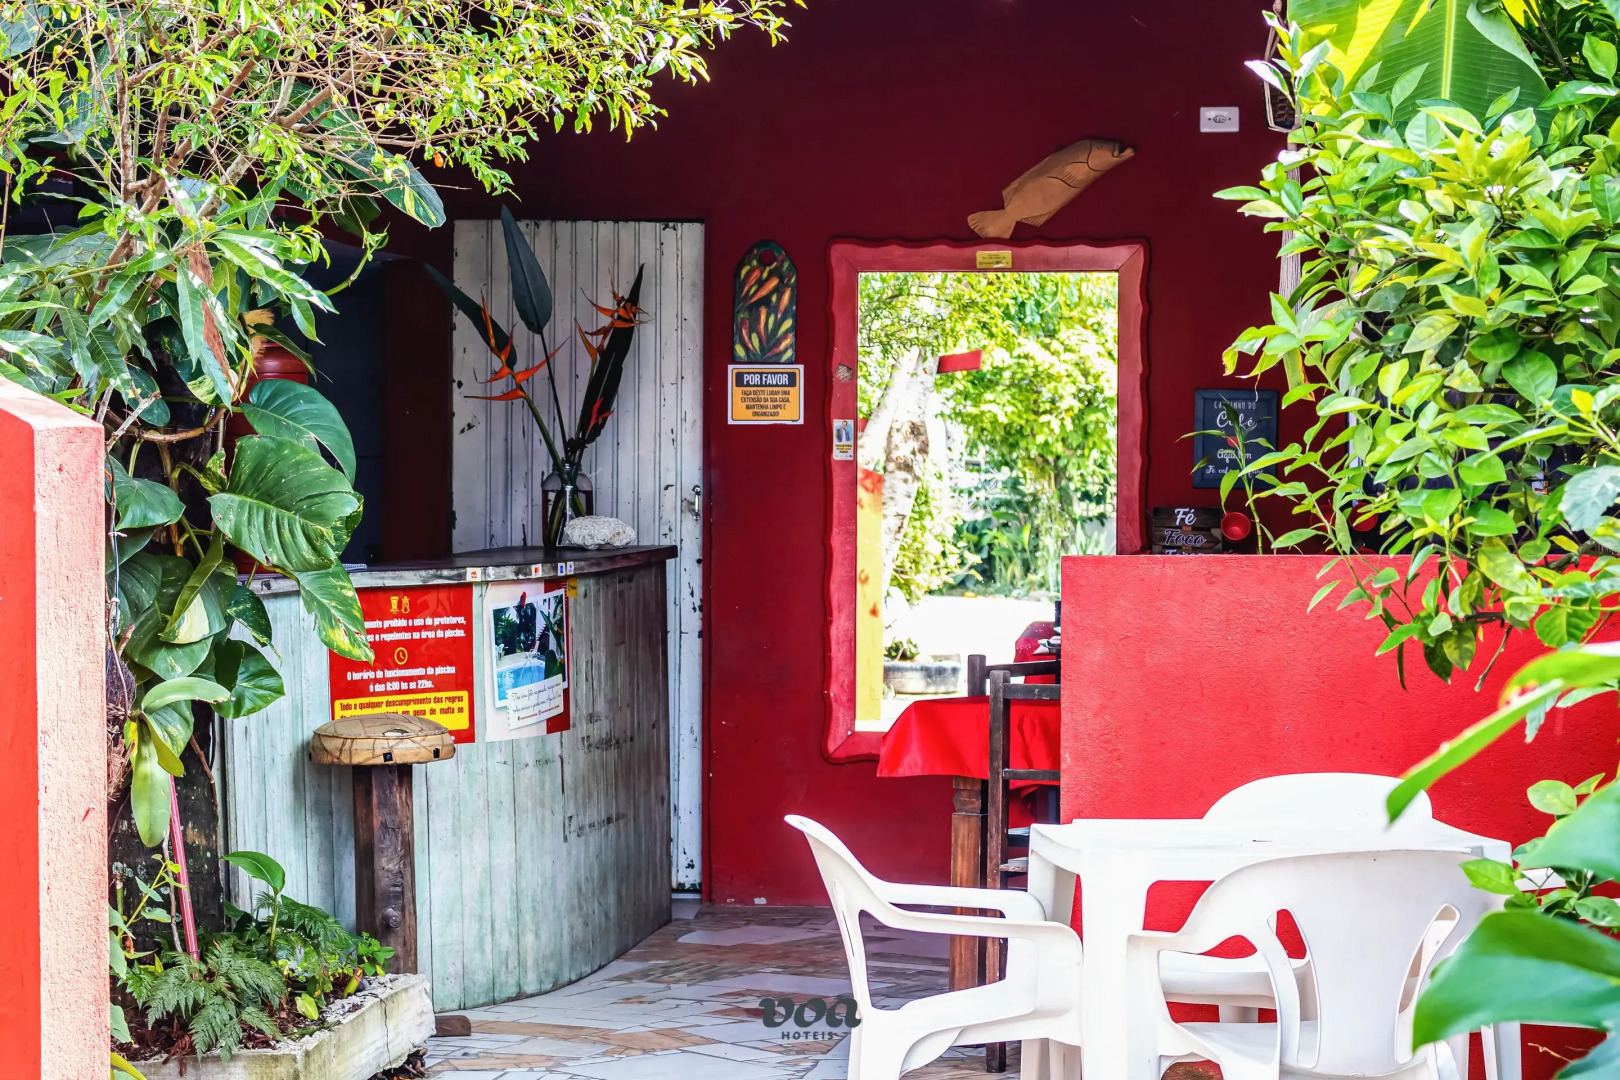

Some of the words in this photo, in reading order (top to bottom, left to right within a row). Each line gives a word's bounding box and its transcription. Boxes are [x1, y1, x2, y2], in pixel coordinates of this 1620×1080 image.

[743, 373, 760, 385] POR
[762, 373, 789, 385] FAVOR
[1248, 401, 1257, 410] DO
[1174, 507, 1197, 526] Fé
[1164, 529, 1207, 547] Foco
[383, 618, 407, 629] proibido
[408, 619, 413, 627] o
[413, 618, 424, 626] uso
[425, 616, 433, 626] de
[433, 616, 466, 626] protetores,
[380, 631, 411, 642] repelentes
[412, 632, 420, 640] na
[421, 629, 435, 639] área
[436, 629, 444, 638] da
[444, 628, 466, 639] piscina.
[347, 671, 352, 681] O
[352, 669, 375, 680] horário
[376, 669, 383, 678] de
[384, 667, 426, 678] funcionamento
[426, 666, 434, 675] da
[435, 665, 456, 676] piscina
[369, 683, 374, 692] é
[374, 682, 385, 691] das
[386, 681, 400, 691] 8:00
[400, 681, 408, 690] hs
[409, 681, 416, 689] as
[417, 680, 434, 689] 22hs.
[340, 702, 352, 711] Todo
[359, 700, 383, 710] qualquer
[386, 696, 431, 707] descumprimento
[433, 695, 443, 704] das
[445, 694, 464, 704] regras
[430, 707, 436, 715] de
[440, 706, 455, 715] multa
[458, 706, 464, 714] no
